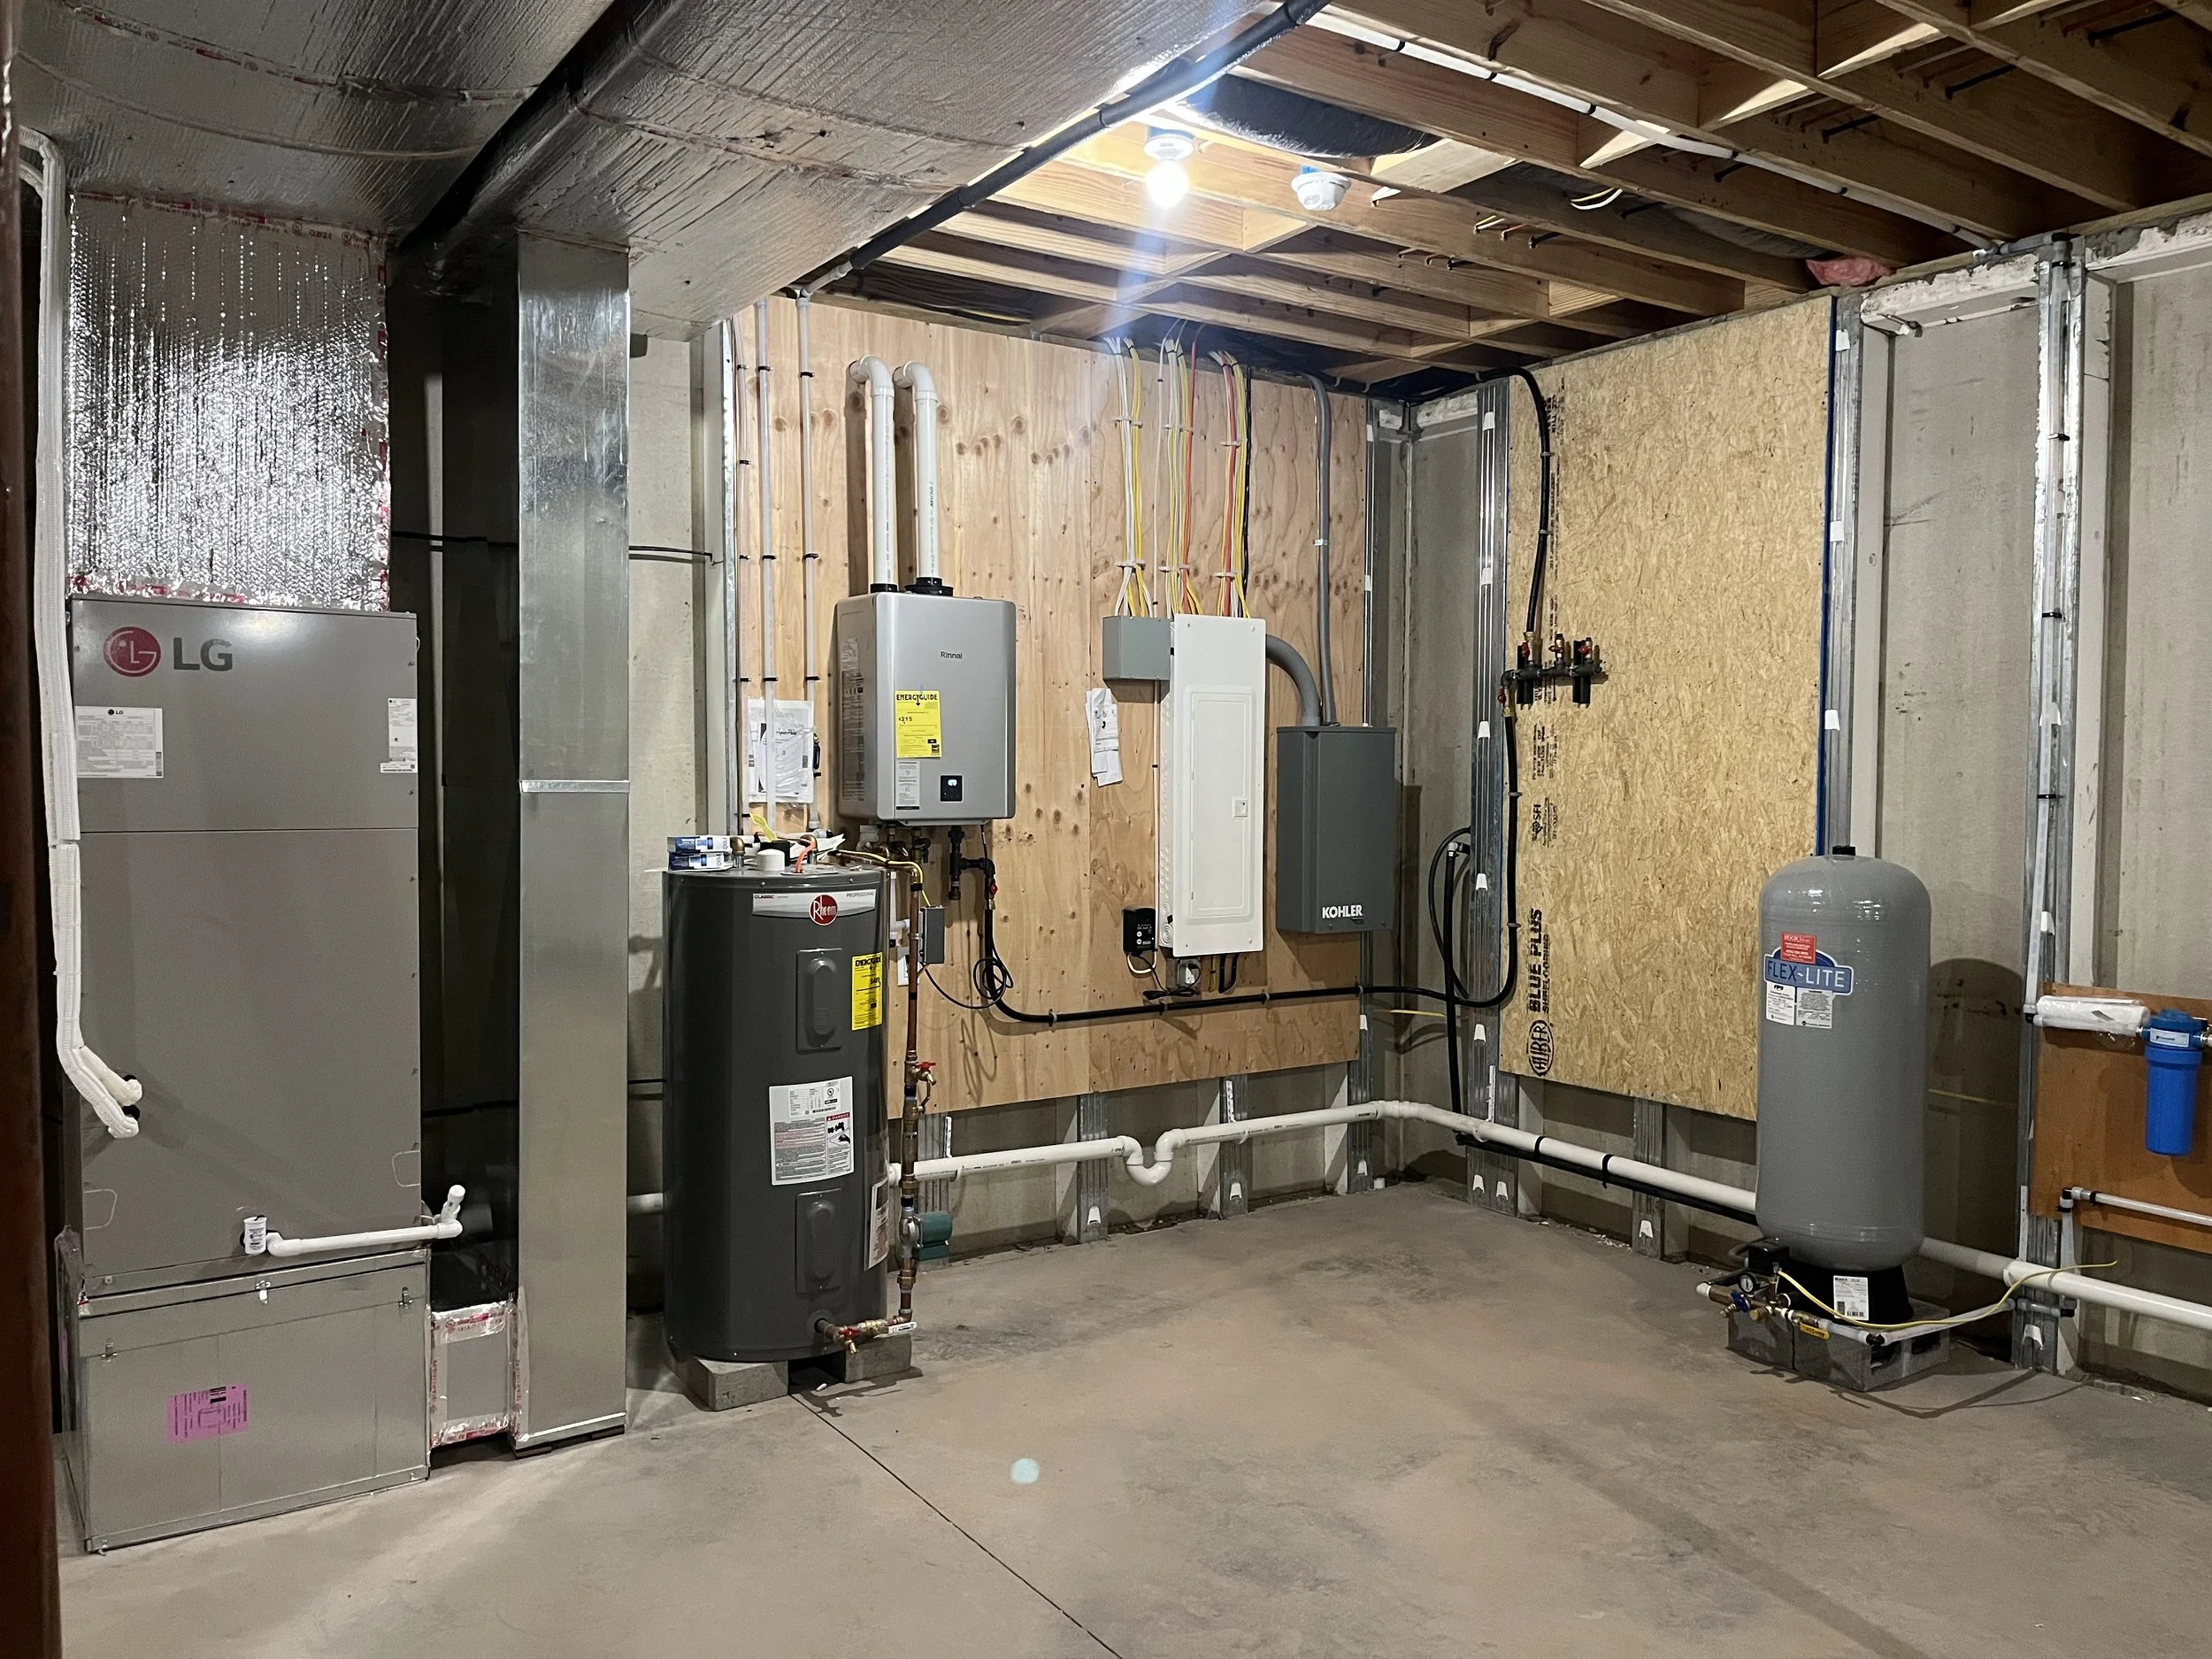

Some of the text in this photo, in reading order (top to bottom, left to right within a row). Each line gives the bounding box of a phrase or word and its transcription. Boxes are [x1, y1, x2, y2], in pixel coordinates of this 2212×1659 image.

[173, 637, 233, 672] LG
[1532, 804, 1541, 821] SFI
[812, 895, 836, 920] Rheem
[1322, 904, 1363, 919] KOHLER
[1529, 908, 1542, 1013] BLUE PLUS
[1530, 1025, 1548, 1071] HUBER
